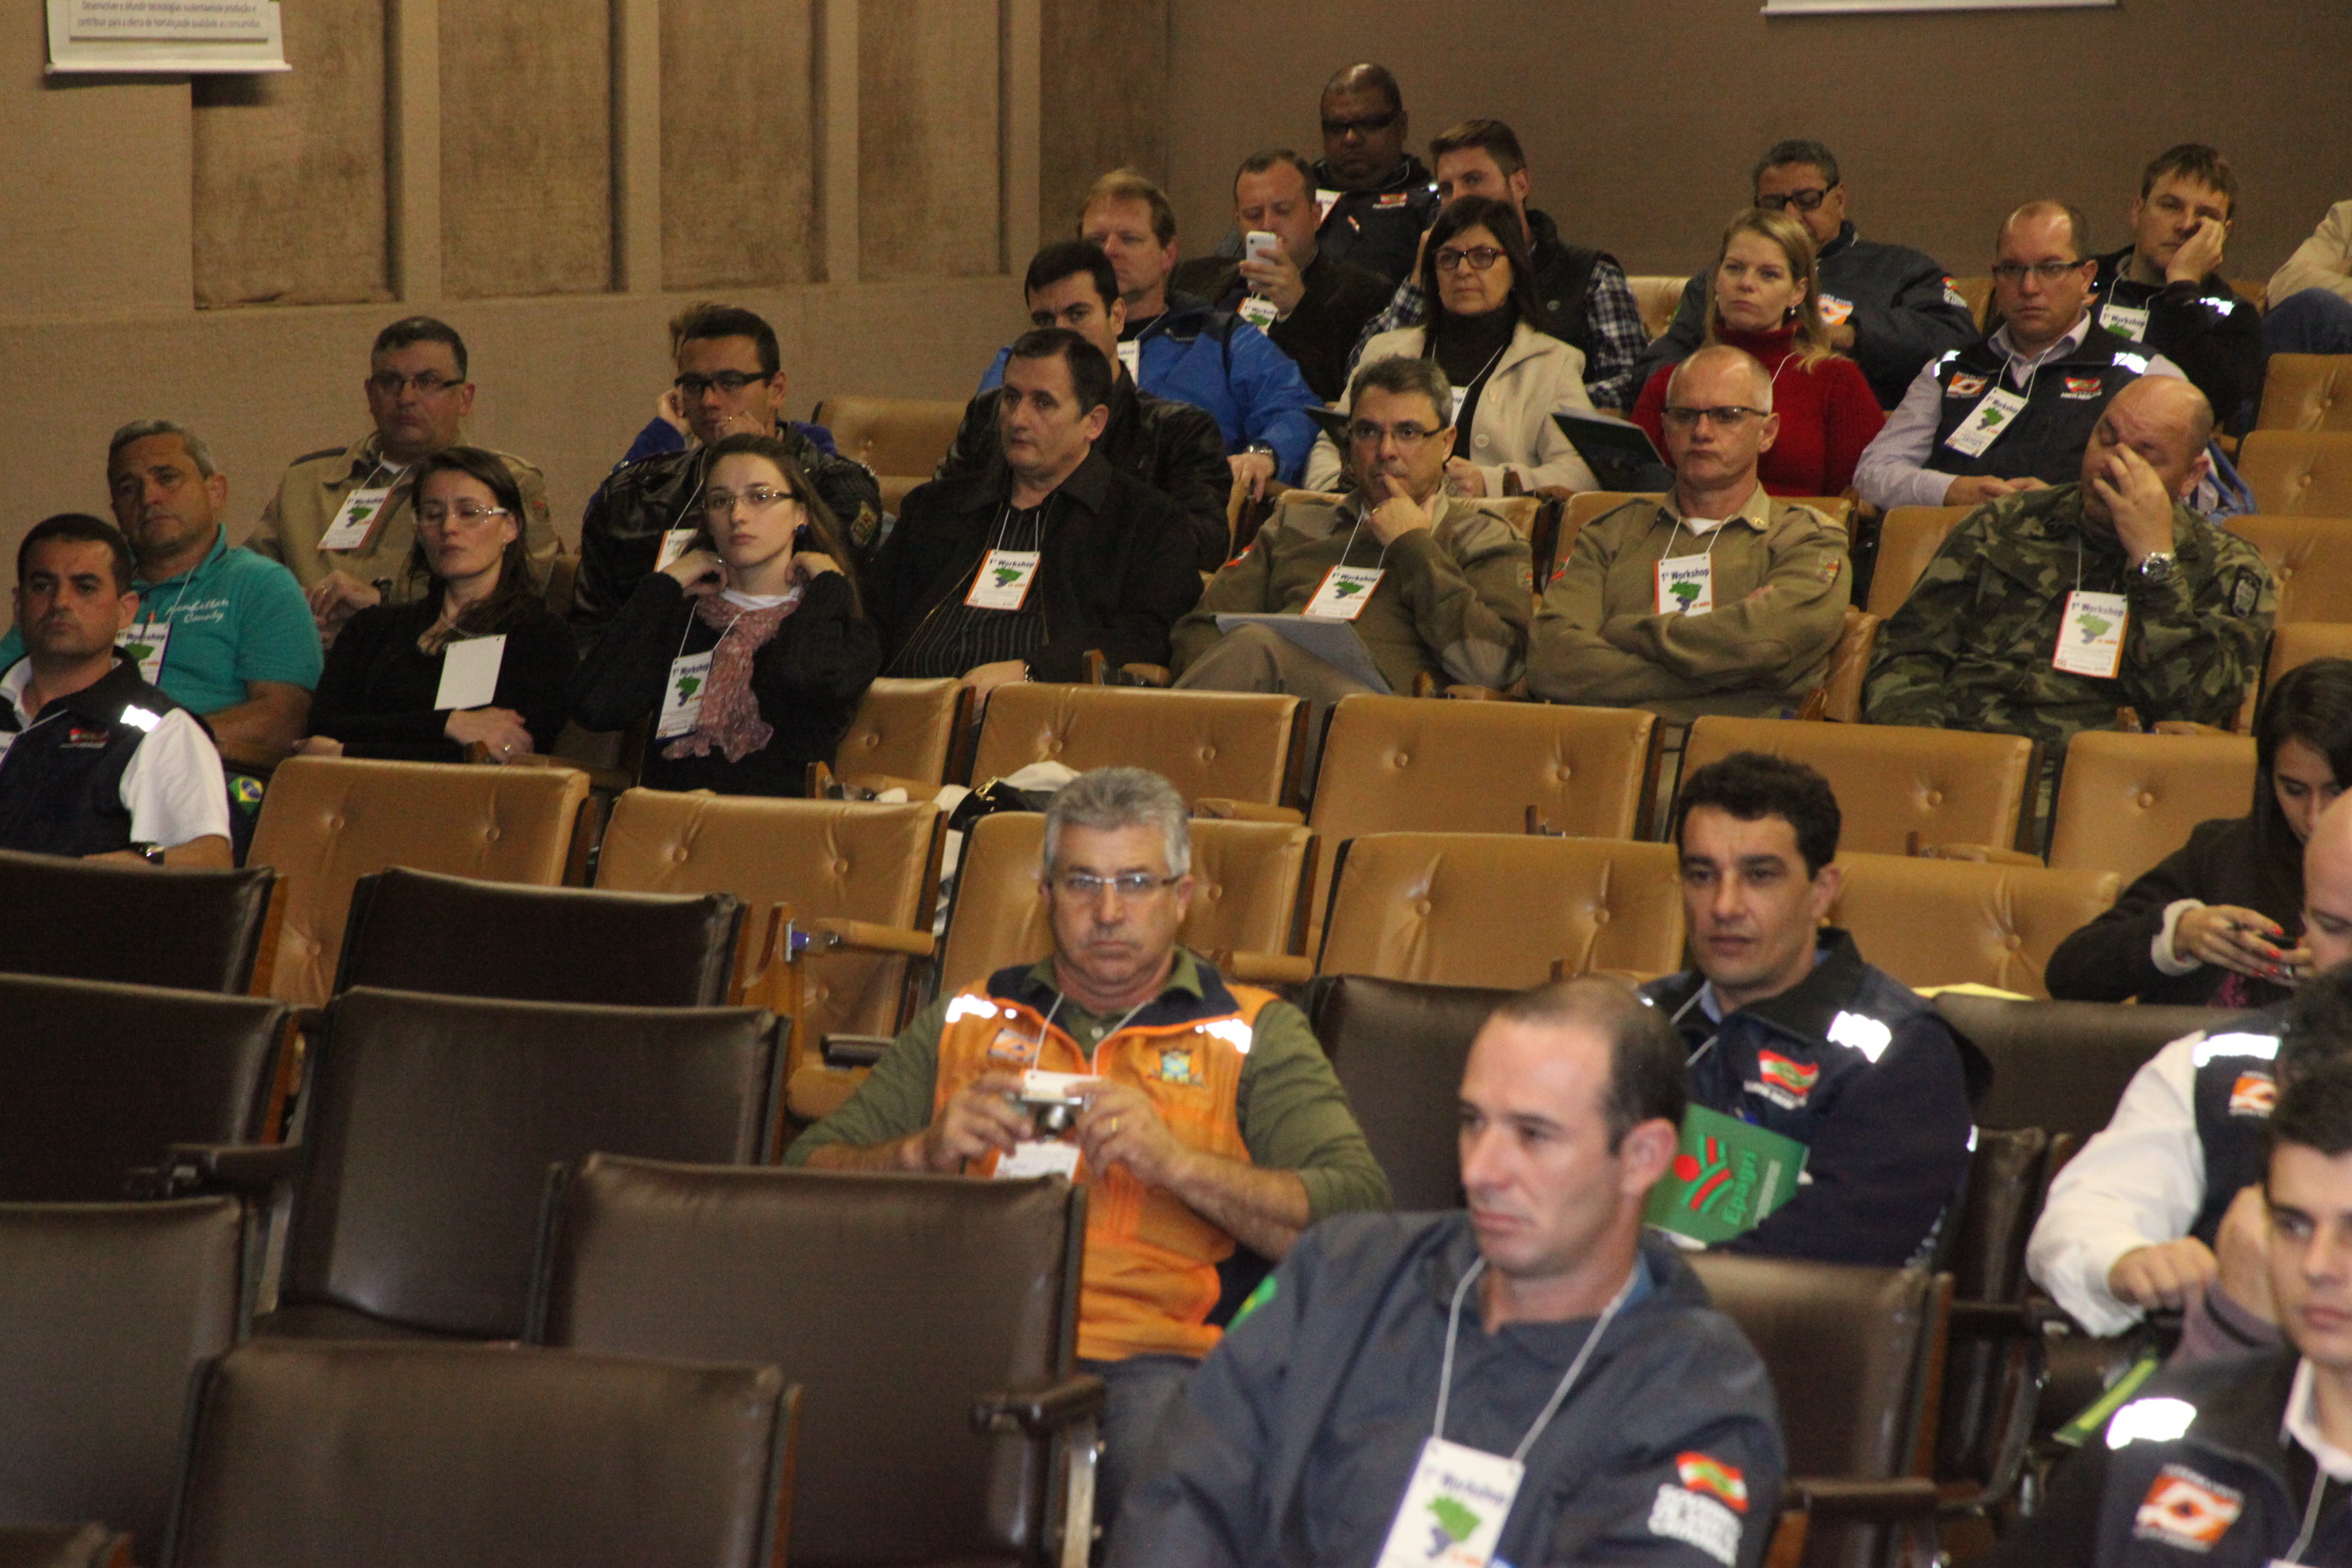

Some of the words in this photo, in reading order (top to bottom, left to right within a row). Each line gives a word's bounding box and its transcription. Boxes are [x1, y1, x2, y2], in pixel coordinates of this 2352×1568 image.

[2111, 313, 2145, 329] Workshop
[999, 558, 1036, 569] Workshop
[1341, 573, 1378, 583] Workshop
[1671, 568, 1710, 581] Workshop
[2082, 602, 2124, 618] Workshop
[680, 663, 710, 676] Workshop
